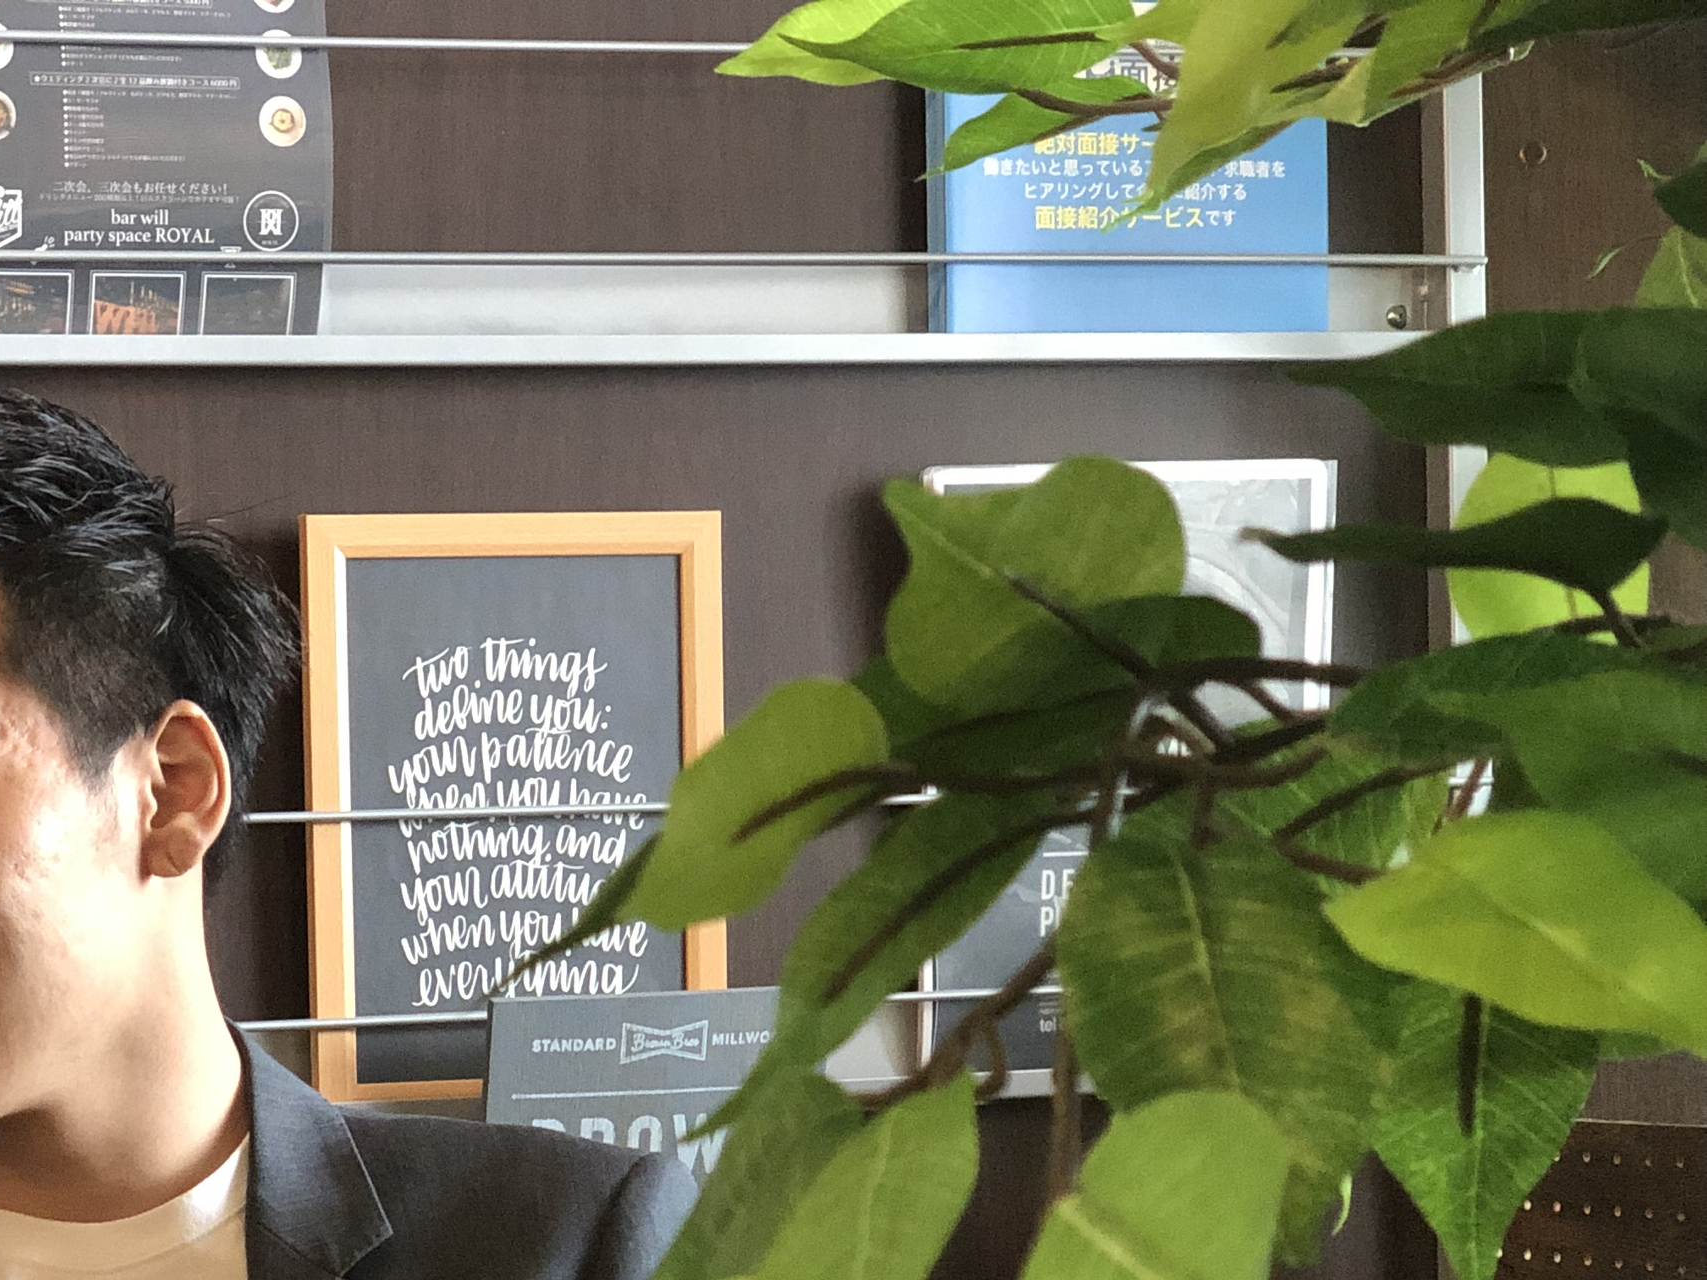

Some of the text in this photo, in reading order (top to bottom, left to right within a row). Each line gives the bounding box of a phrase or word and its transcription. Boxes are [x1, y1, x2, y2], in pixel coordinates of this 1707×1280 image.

[63, 227, 215, 247] party space ROYAL
[111, 208, 170, 226] bar will
[402, 638, 608, 699] two things
[415, 680, 612, 741] define you:
[388, 727, 634, 809] your patience
[555, 823, 627, 869] and
[400, 857, 608, 927] your attitu
[400, 915, 496, 966] when
[499, 909, 562, 961] you
[531, 1037, 617, 1053] STANDARD
[712, 1029, 771, 1046] MILLWO
